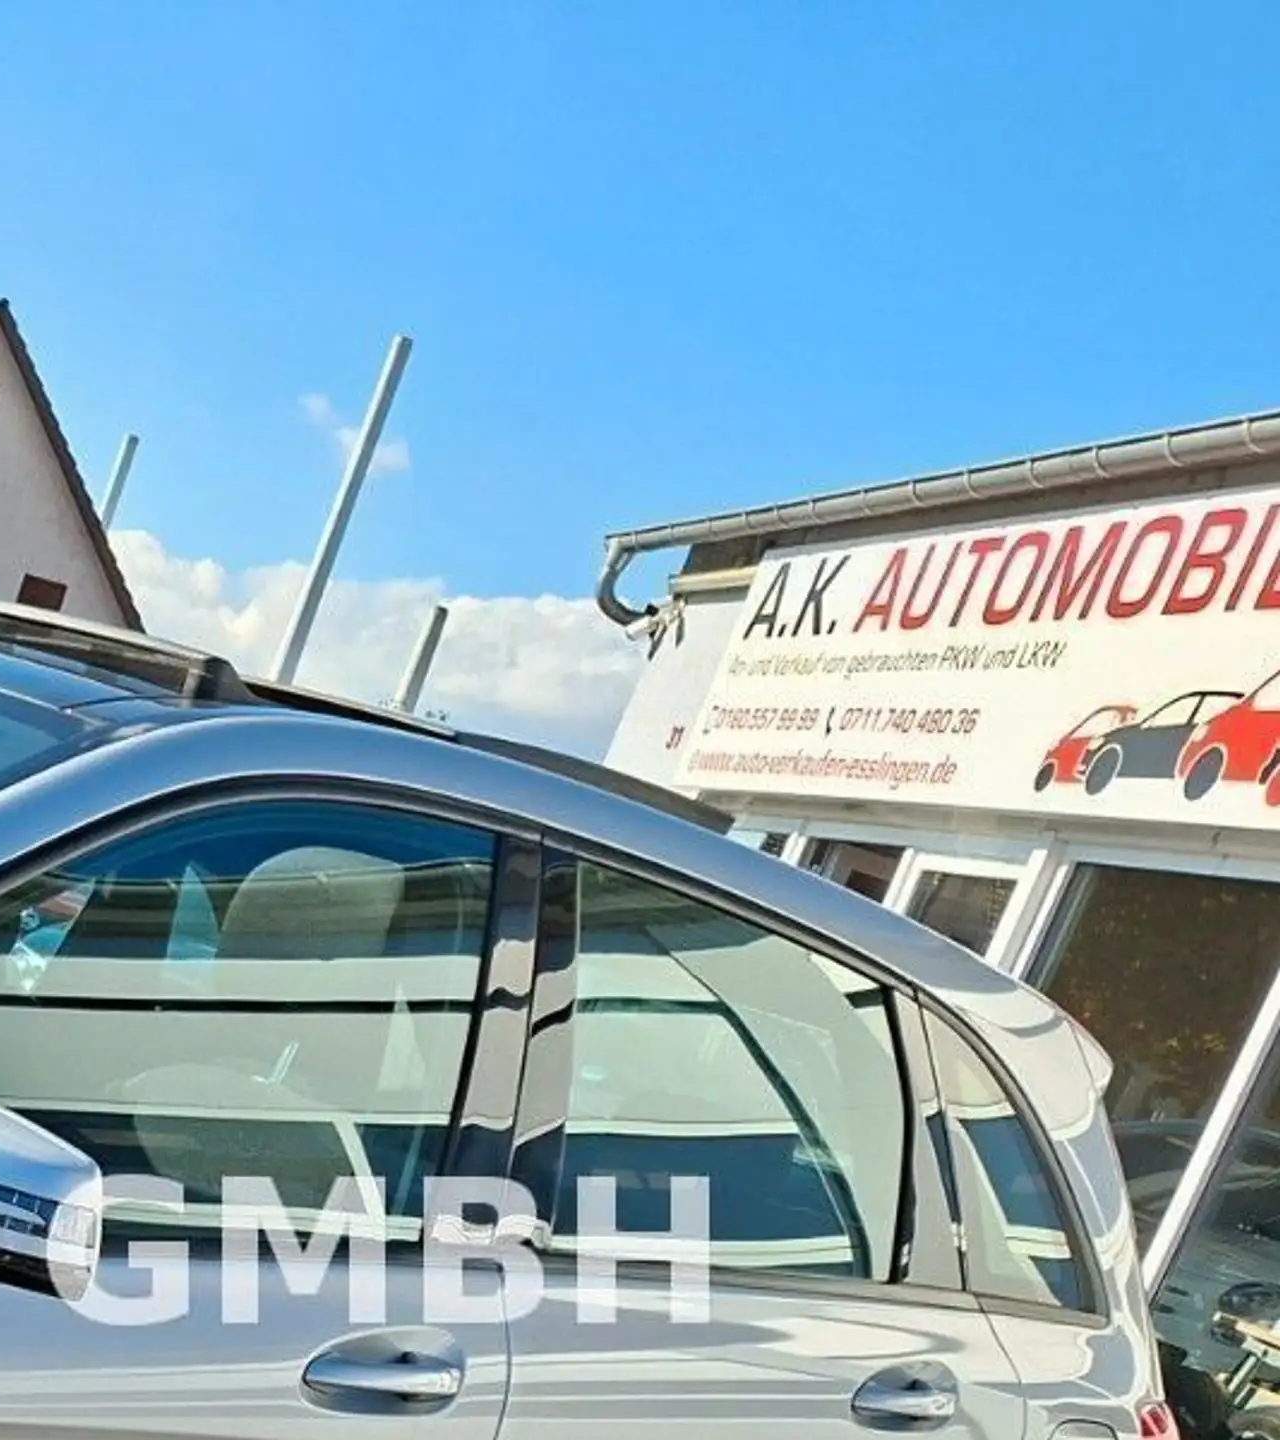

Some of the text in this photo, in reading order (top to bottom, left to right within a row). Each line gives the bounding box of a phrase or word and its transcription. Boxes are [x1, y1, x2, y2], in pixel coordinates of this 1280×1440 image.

[742, 553, 852, 641] A.K.
[844, 647, 938, 680] gebrauchten
[938, 643, 986, 671] PKW
[982, 642, 1019, 671] und
[1017, 638, 1069, 670] LKW
